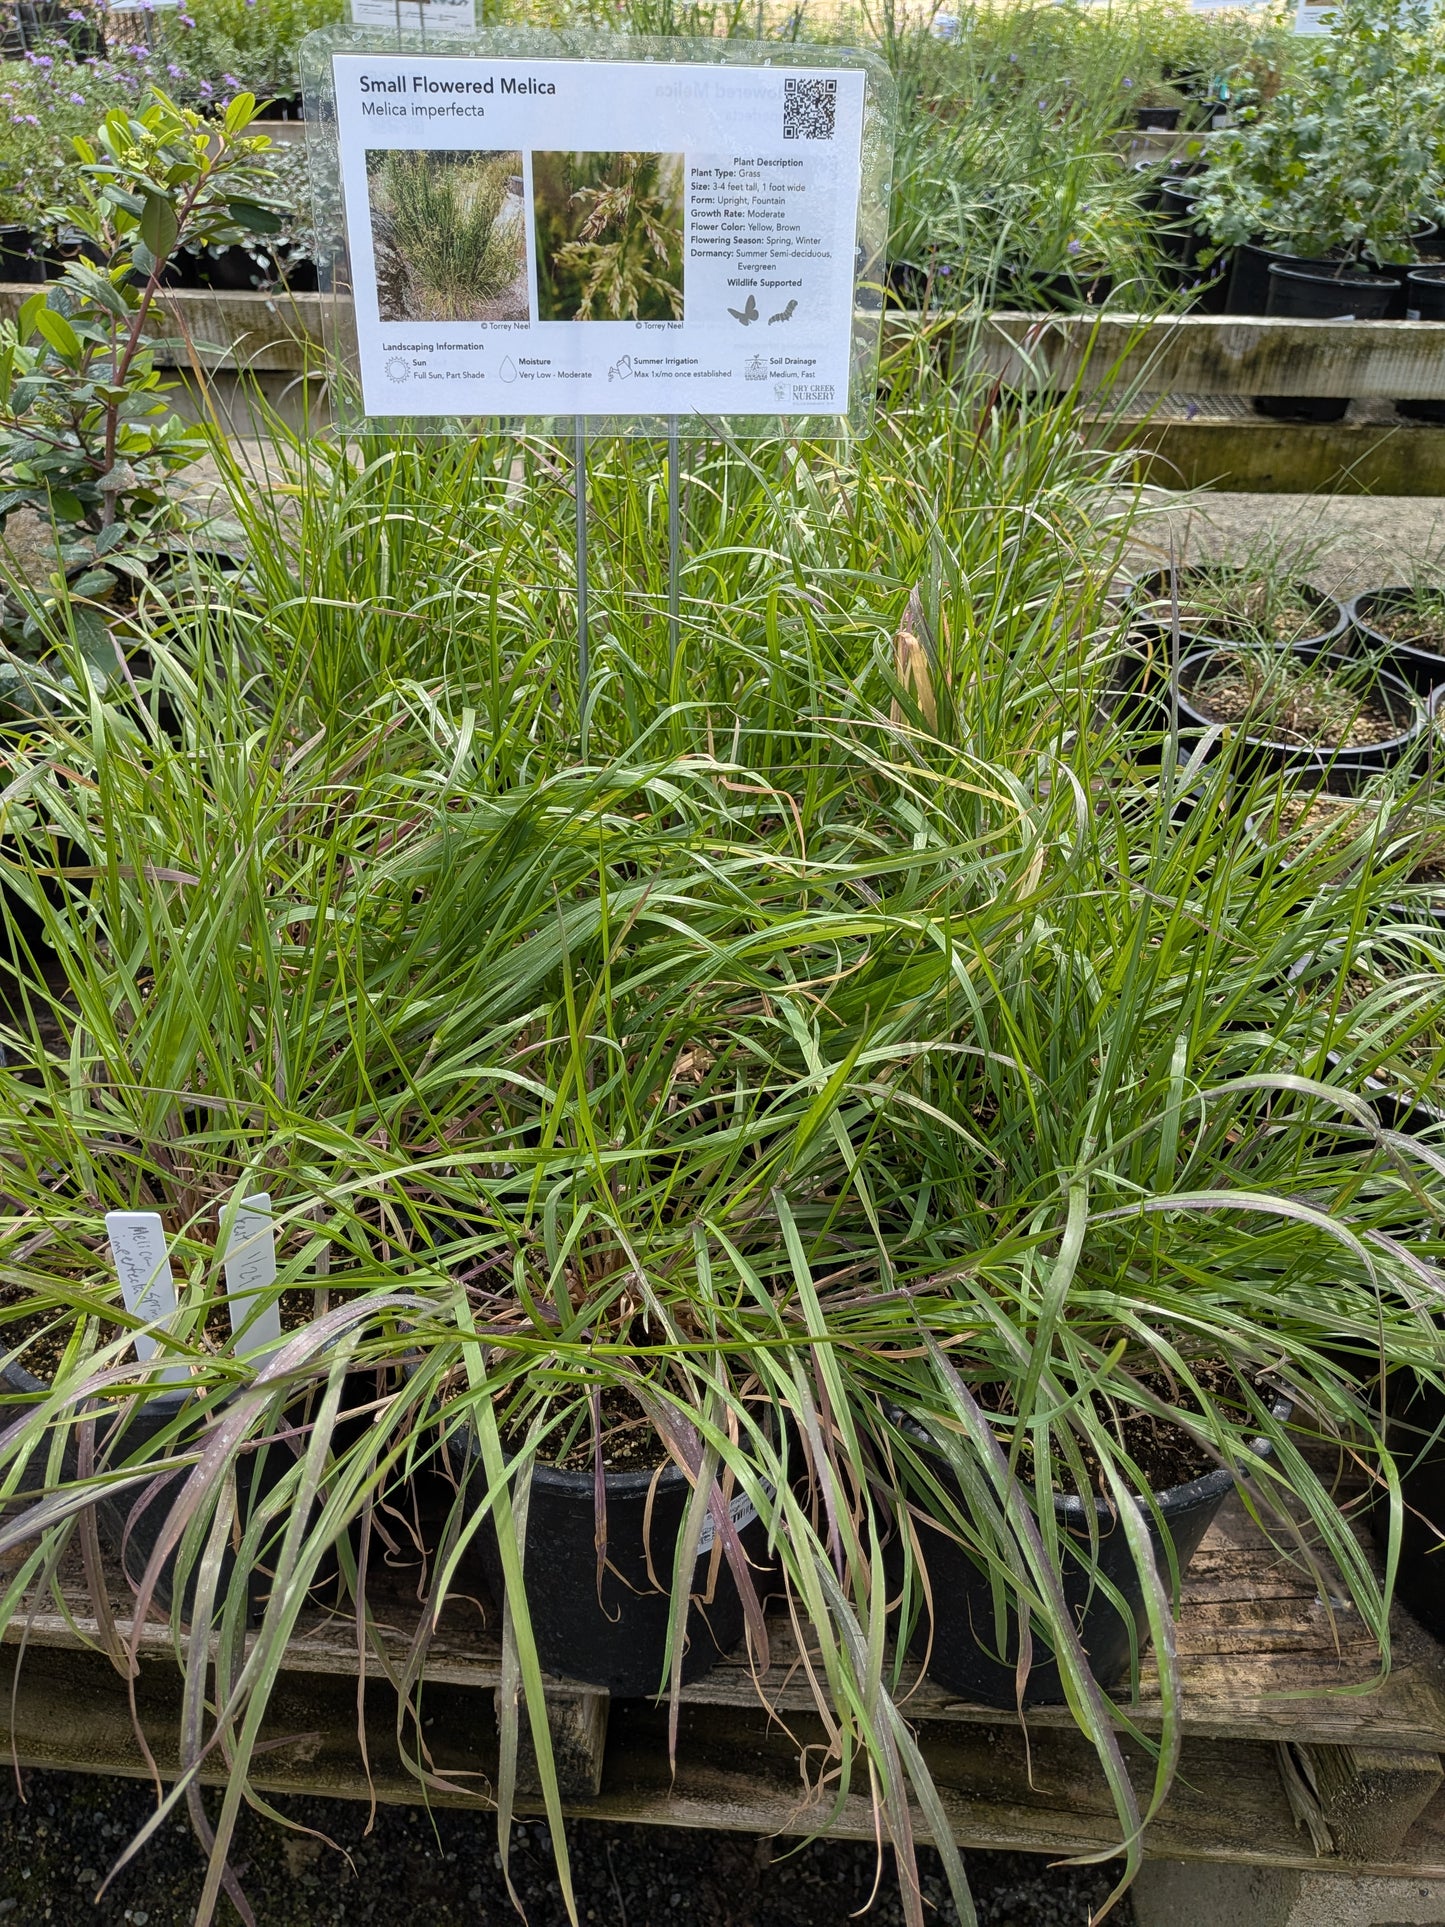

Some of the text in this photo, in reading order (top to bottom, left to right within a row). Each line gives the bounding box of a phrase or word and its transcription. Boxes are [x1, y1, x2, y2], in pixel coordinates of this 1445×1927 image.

[359, 75, 556, 95] Small Flowered Melica
[362, 102, 485, 120] Melica imperfecta
[733, 157, 803, 168] Plant Description
[691, 168, 761, 179] Plant Type: Grass
[691, 182, 806, 192] Size: 3-4 feet tall, 1 foot wide
[691, 196, 786, 206] Form: Upright, Fountain
[691, 209, 785, 218] Growth Rate: Moderate
[690, 222, 801, 232] Flower Color: Yellow, Brown
[690, 235, 821, 247] Flowering Season: Spring, Winter
[690, 249, 832, 259] Dormancy: Summer Semi-deciduous,
[738, 262, 776, 273] Evergreen
[727, 278, 802, 289] Wildlife Supported
[490, 322, 512, 331] Torrey
[514, 322, 531, 330] Neel
[644, 322, 666, 331] Torrey
[382, 342, 484, 352] Landscaping Information
[633, 357, 699, 366] Summer Irrigation
[769, 357, 817, 366] Soil Drainage
[428, 372, 445, 380] Sun,
[446, 371, 461, 379] Part
[463, 371, 485, 379] Shade
[519, 371, 535, 380] Very
[536, 371, 551, 379] Low
[558, 371, 592, 379] Moderate
[651, 370, 673, 379] 1x/mo
[693, 370, 732, 378] established
[769, 370, 799, 379] Medium,
[792, 391, 835, 401] NURSERY
